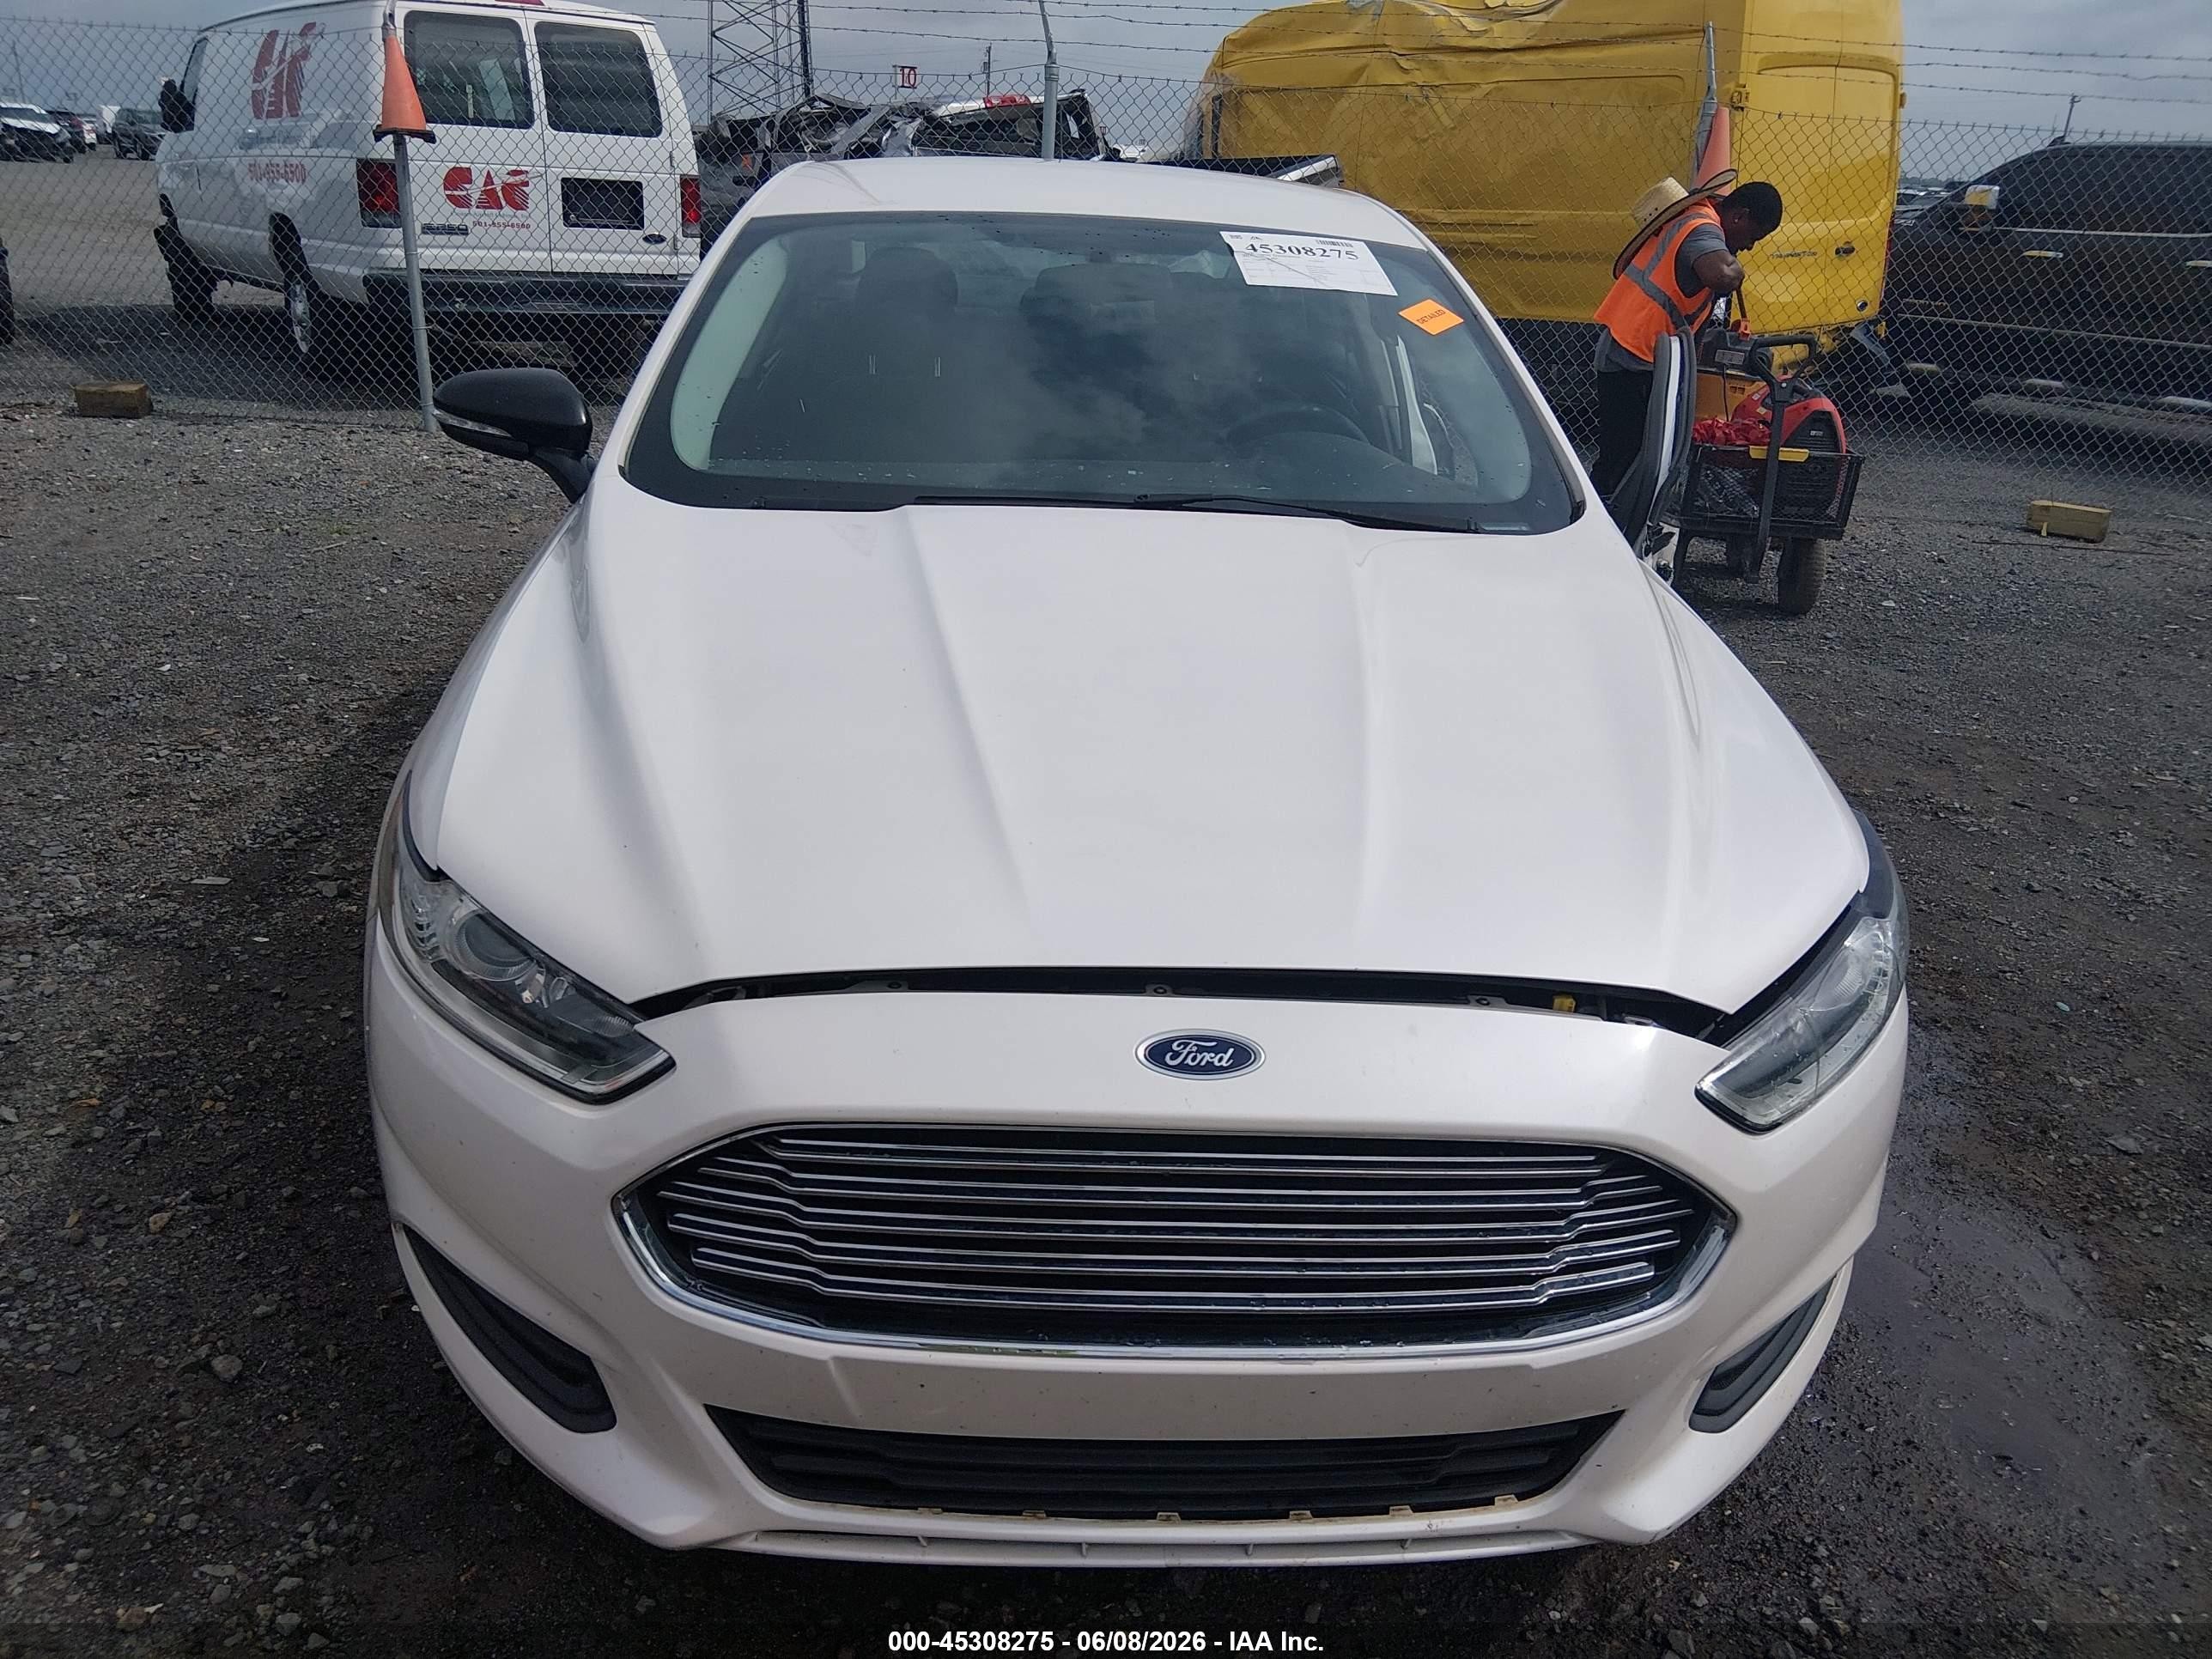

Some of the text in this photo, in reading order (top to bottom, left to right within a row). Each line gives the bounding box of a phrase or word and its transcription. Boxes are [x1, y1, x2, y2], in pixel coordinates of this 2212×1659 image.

[899, 68, 916, 88] 10
[1245, 243, 1359, 261] 45308275
[1416, 309, 1446, 325] DETAILED
[1164, 1038, 1236, 1067] Ford
